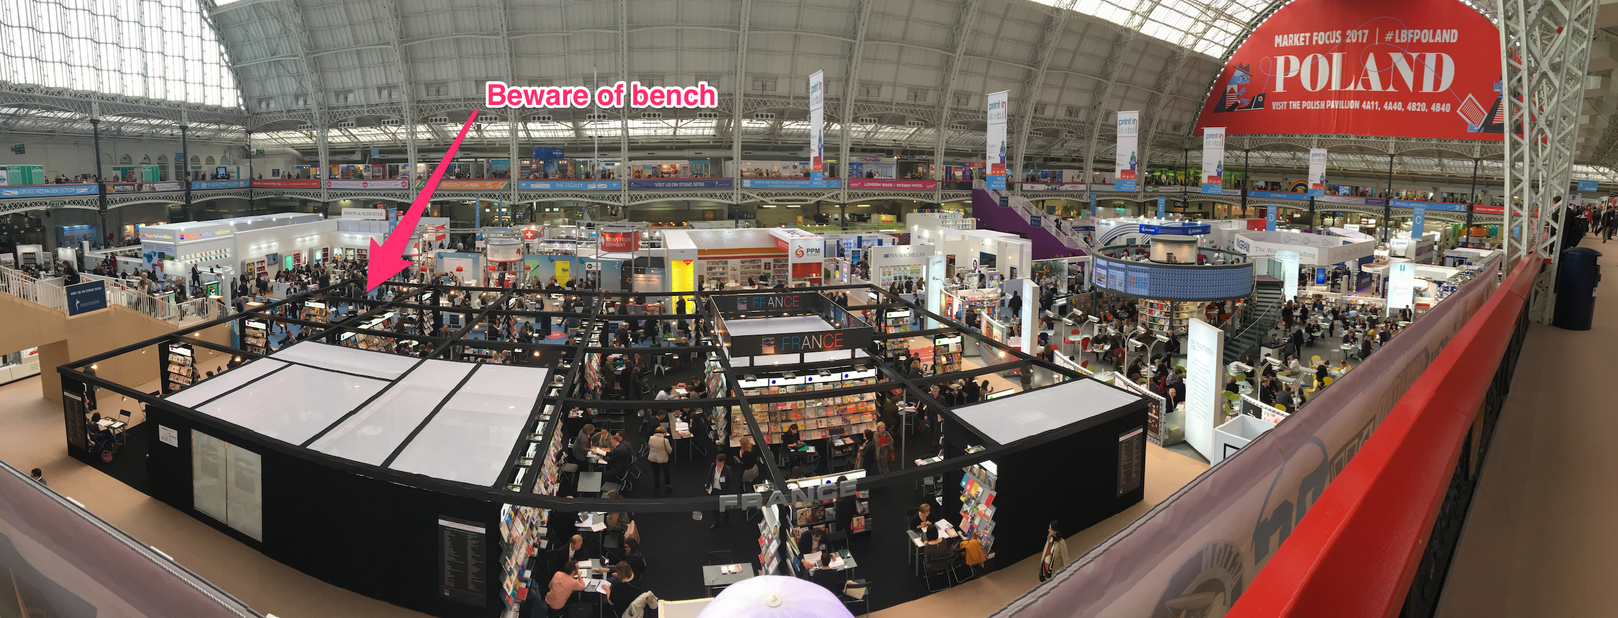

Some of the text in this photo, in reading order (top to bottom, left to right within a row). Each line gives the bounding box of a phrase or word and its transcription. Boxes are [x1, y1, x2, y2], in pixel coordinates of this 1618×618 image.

[1274, 28, 1458, 48] MARKET FOCUS 2017 #LBFPOLAND
[1272, 52, 1455, 93] POLAND
[989, 101, 1000, 111] print
[1272, 99, 1451, 113] VISIT THE POLISH PAVILLION 4A11, 4A40, 4B20, 4B40
[1118, 117, 1131, 126] print
[1206, 132, 1218, 140] print
[1268, 213, 1275, 221] D
[1415, 215, 1422, 224] C
[782, 333, 843, 351] FRANCE
[719, 478, 858, 512] FRANCE
